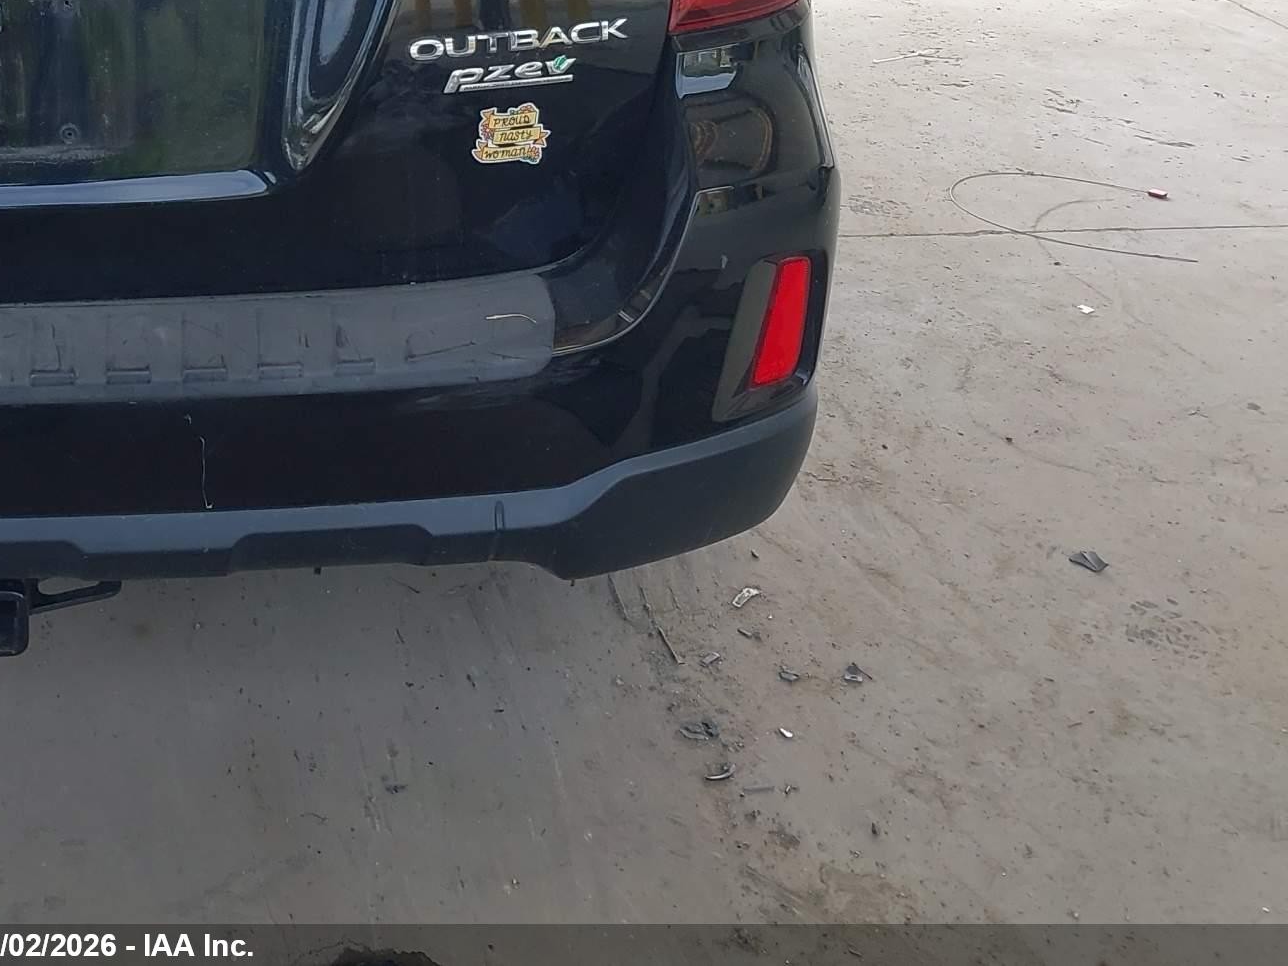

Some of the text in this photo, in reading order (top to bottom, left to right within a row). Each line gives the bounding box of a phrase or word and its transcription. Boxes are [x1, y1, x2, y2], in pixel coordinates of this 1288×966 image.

[408, 17, 629, 62] OUTBACK
[493, 114, 531, 128] PROUD
[500, 129, 533, 143] nasty
[483, 146, 527, 159] woman
